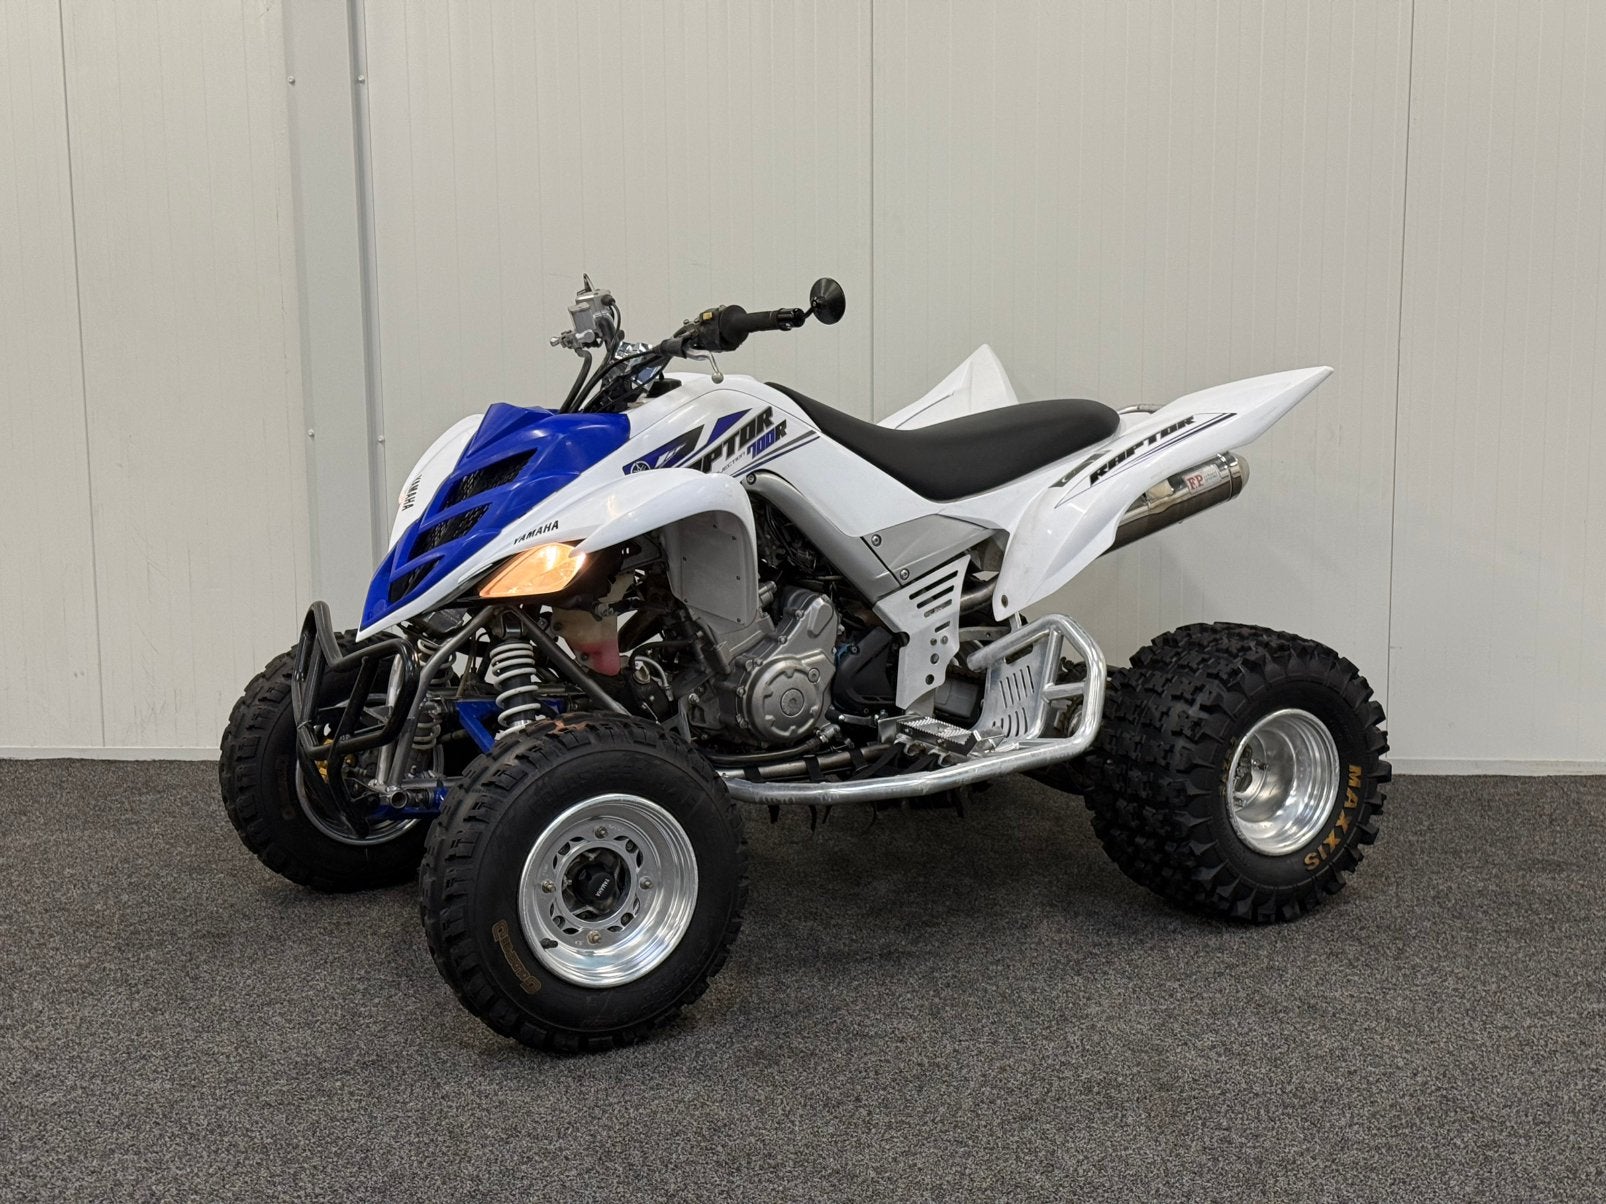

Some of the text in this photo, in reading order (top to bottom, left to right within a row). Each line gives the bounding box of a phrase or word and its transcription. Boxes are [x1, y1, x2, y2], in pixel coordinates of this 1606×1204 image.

[746, 418, 787, 460] 700R
[1090, 415, 1196, 487] RAPTOR
[401, 473, 422, 512] YAMAHA
[513, 519, 559, 545] YAMAHA
[1304, 764, 1362, 870] MAXXIS
